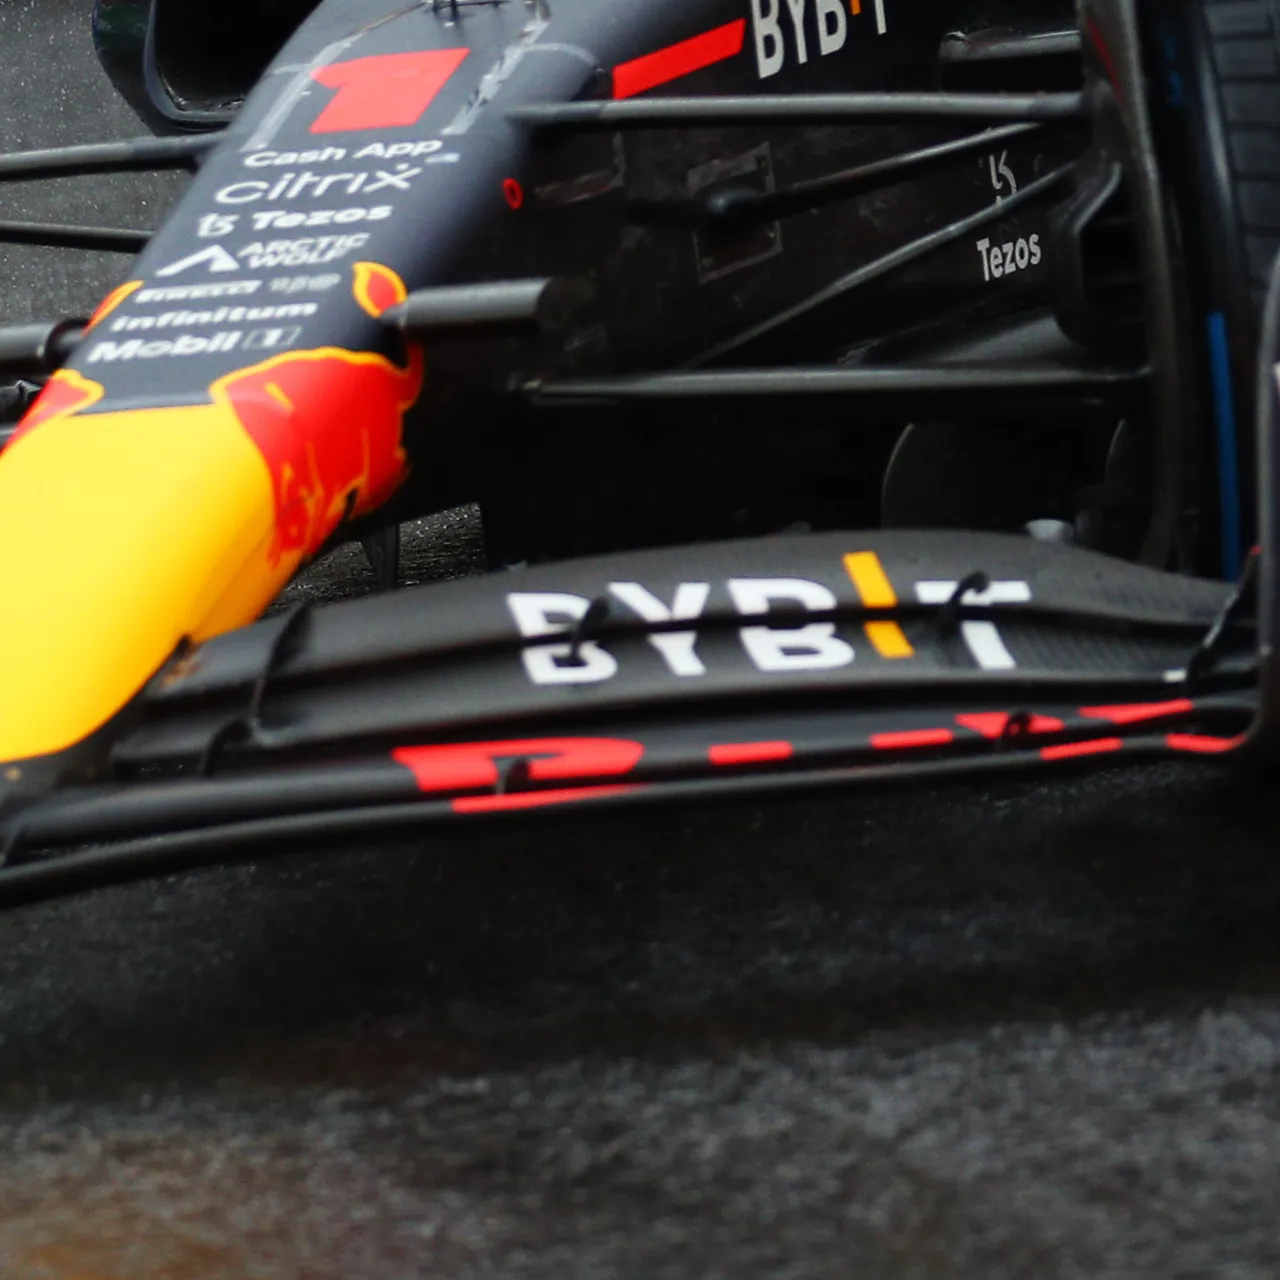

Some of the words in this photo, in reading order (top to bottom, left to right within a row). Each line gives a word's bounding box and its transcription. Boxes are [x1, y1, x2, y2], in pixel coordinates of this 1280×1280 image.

[308, 47, 472, 134] 1
[244, 145, 347, 168] Cash
[352, 139, 444, 161] App
[251, 205, 394, 231] Tezos
[975, 232, 1042, 282] Tezos
[86, 330, 244, 364] Mobil
